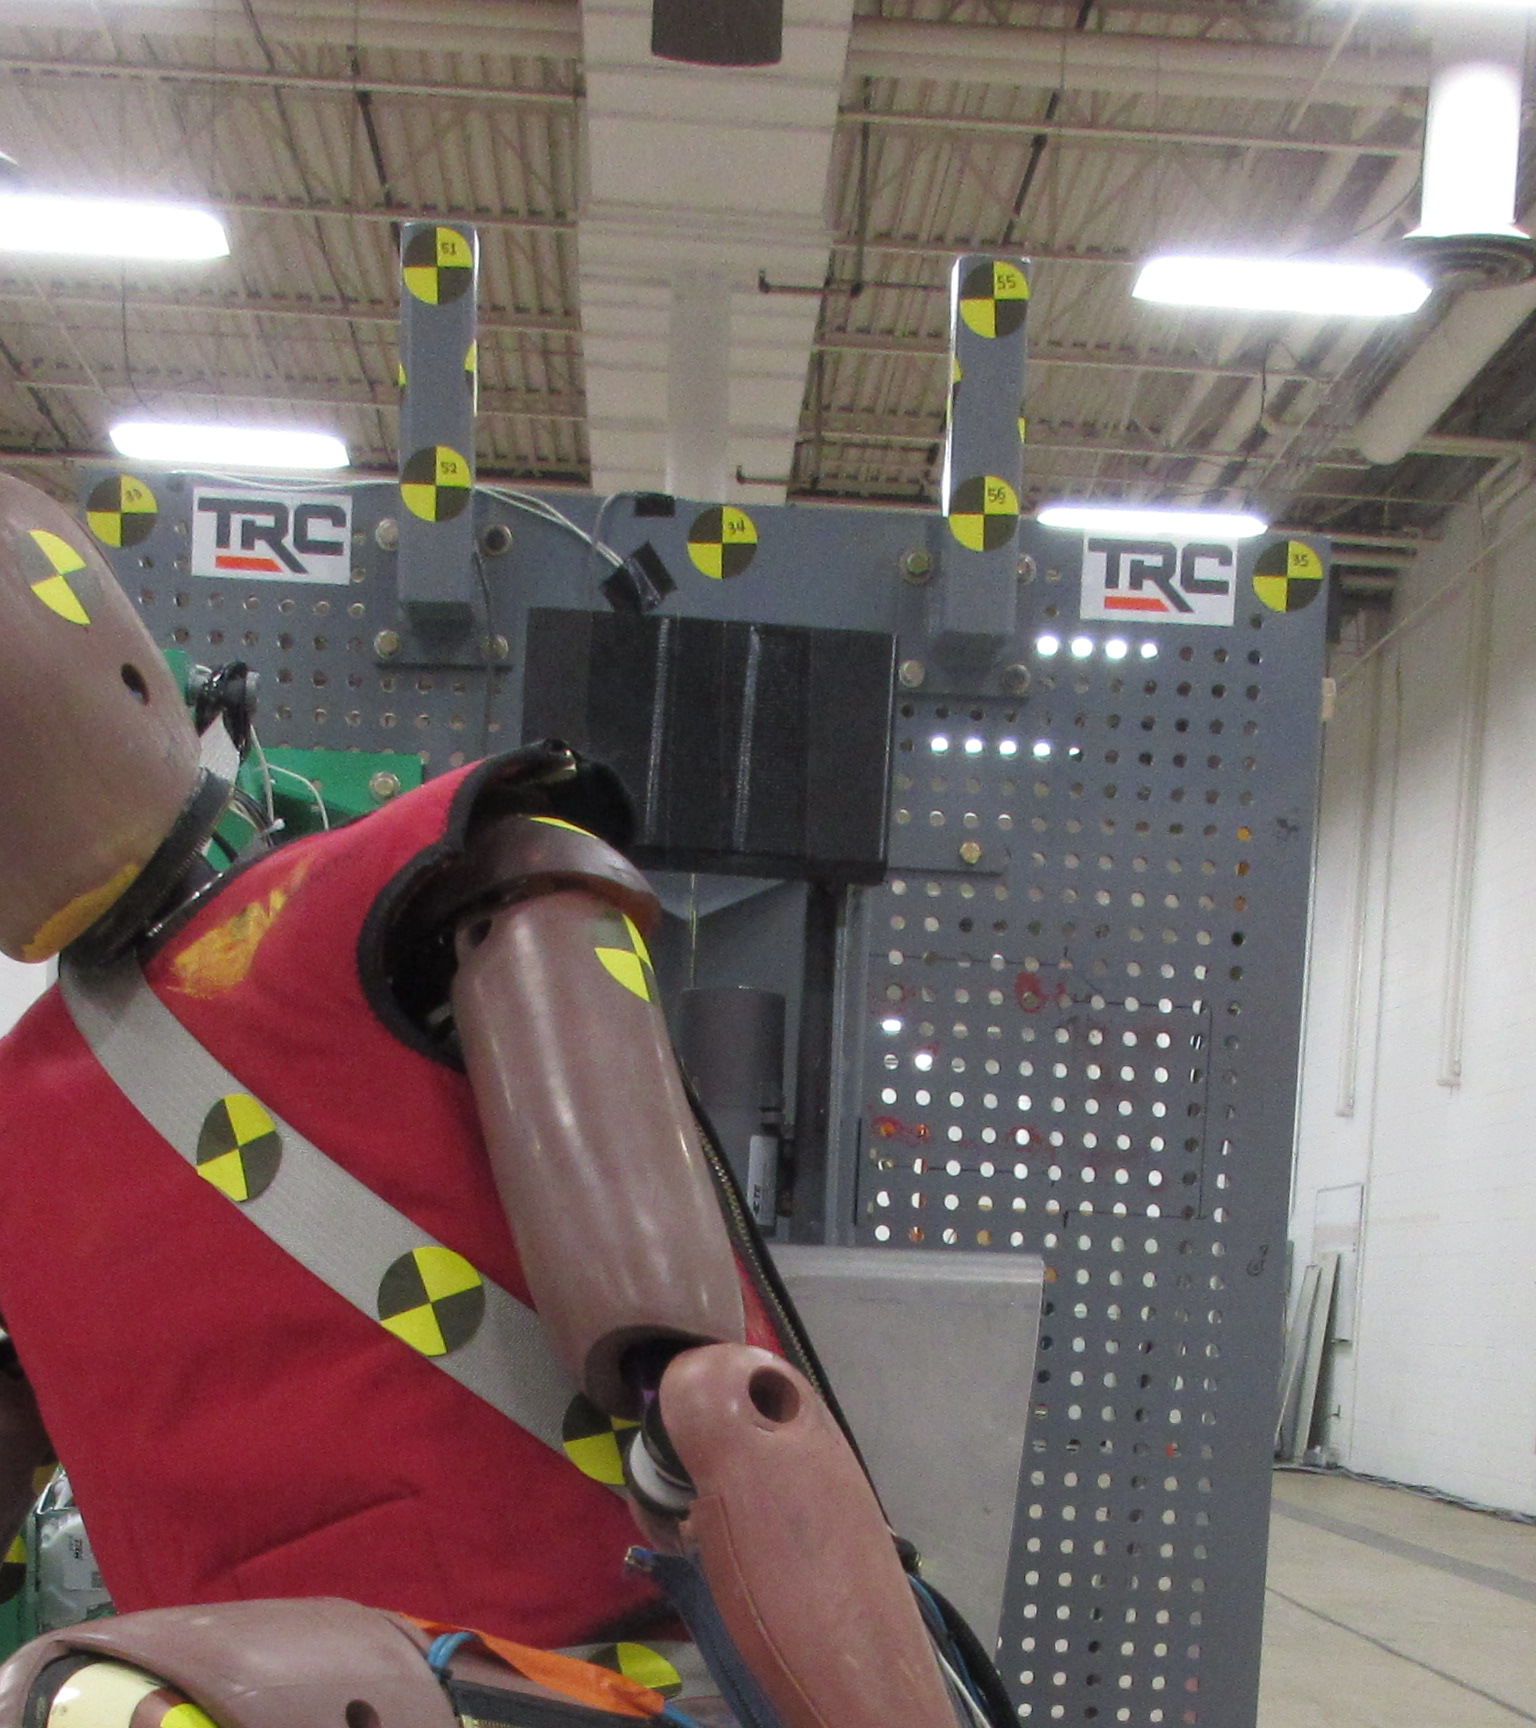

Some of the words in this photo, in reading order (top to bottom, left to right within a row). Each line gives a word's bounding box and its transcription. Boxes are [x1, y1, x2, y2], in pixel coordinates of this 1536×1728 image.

[997, 274, 1016, 290] 55
[440, 461, 457, 475] 52
[198, 497, 347, 574] TRC
[1088, 538, 1233, 613] TRC
